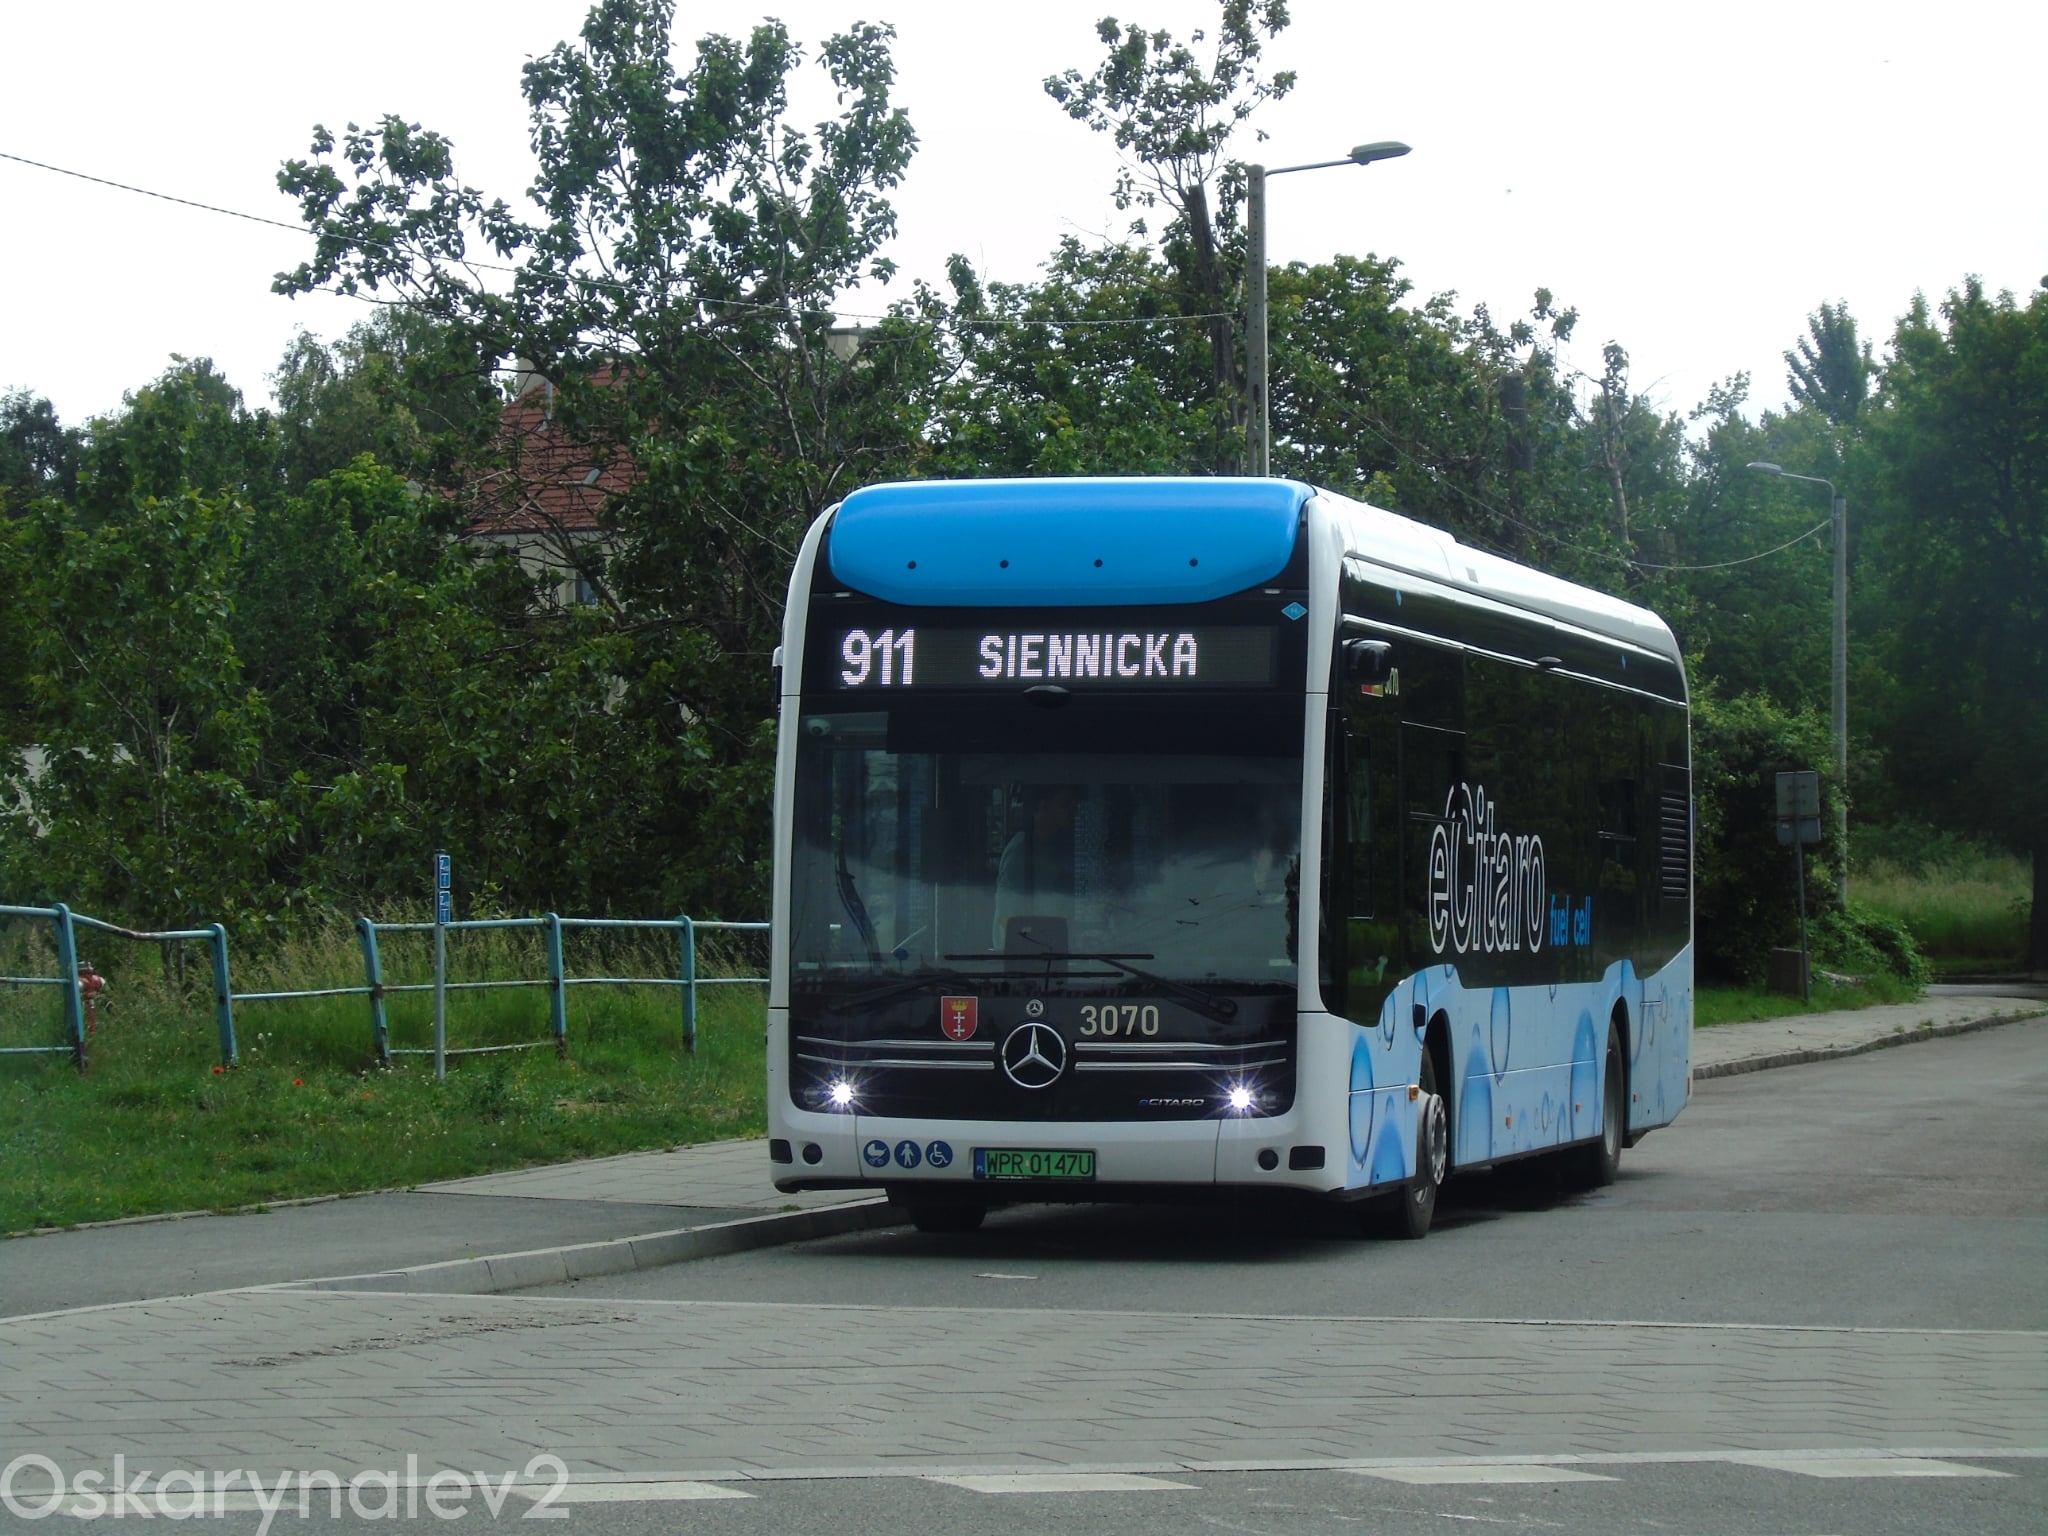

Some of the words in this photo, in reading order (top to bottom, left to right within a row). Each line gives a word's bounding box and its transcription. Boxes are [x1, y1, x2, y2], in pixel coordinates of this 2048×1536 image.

[841, 629, 914, 685] 911
[979, 634, 1197, 677] SIENNICKA
[1429, 782, 1545, 953] eCitaro
[1550, 894, 1570, 946] fuel
[1573, 895, 1591, 946] cell
[1080, 1005, 1159, 1036] 3070
[986, 1152, 1024, 1174] WPR
[1030, 1154, 1092, 1175] 0147U
